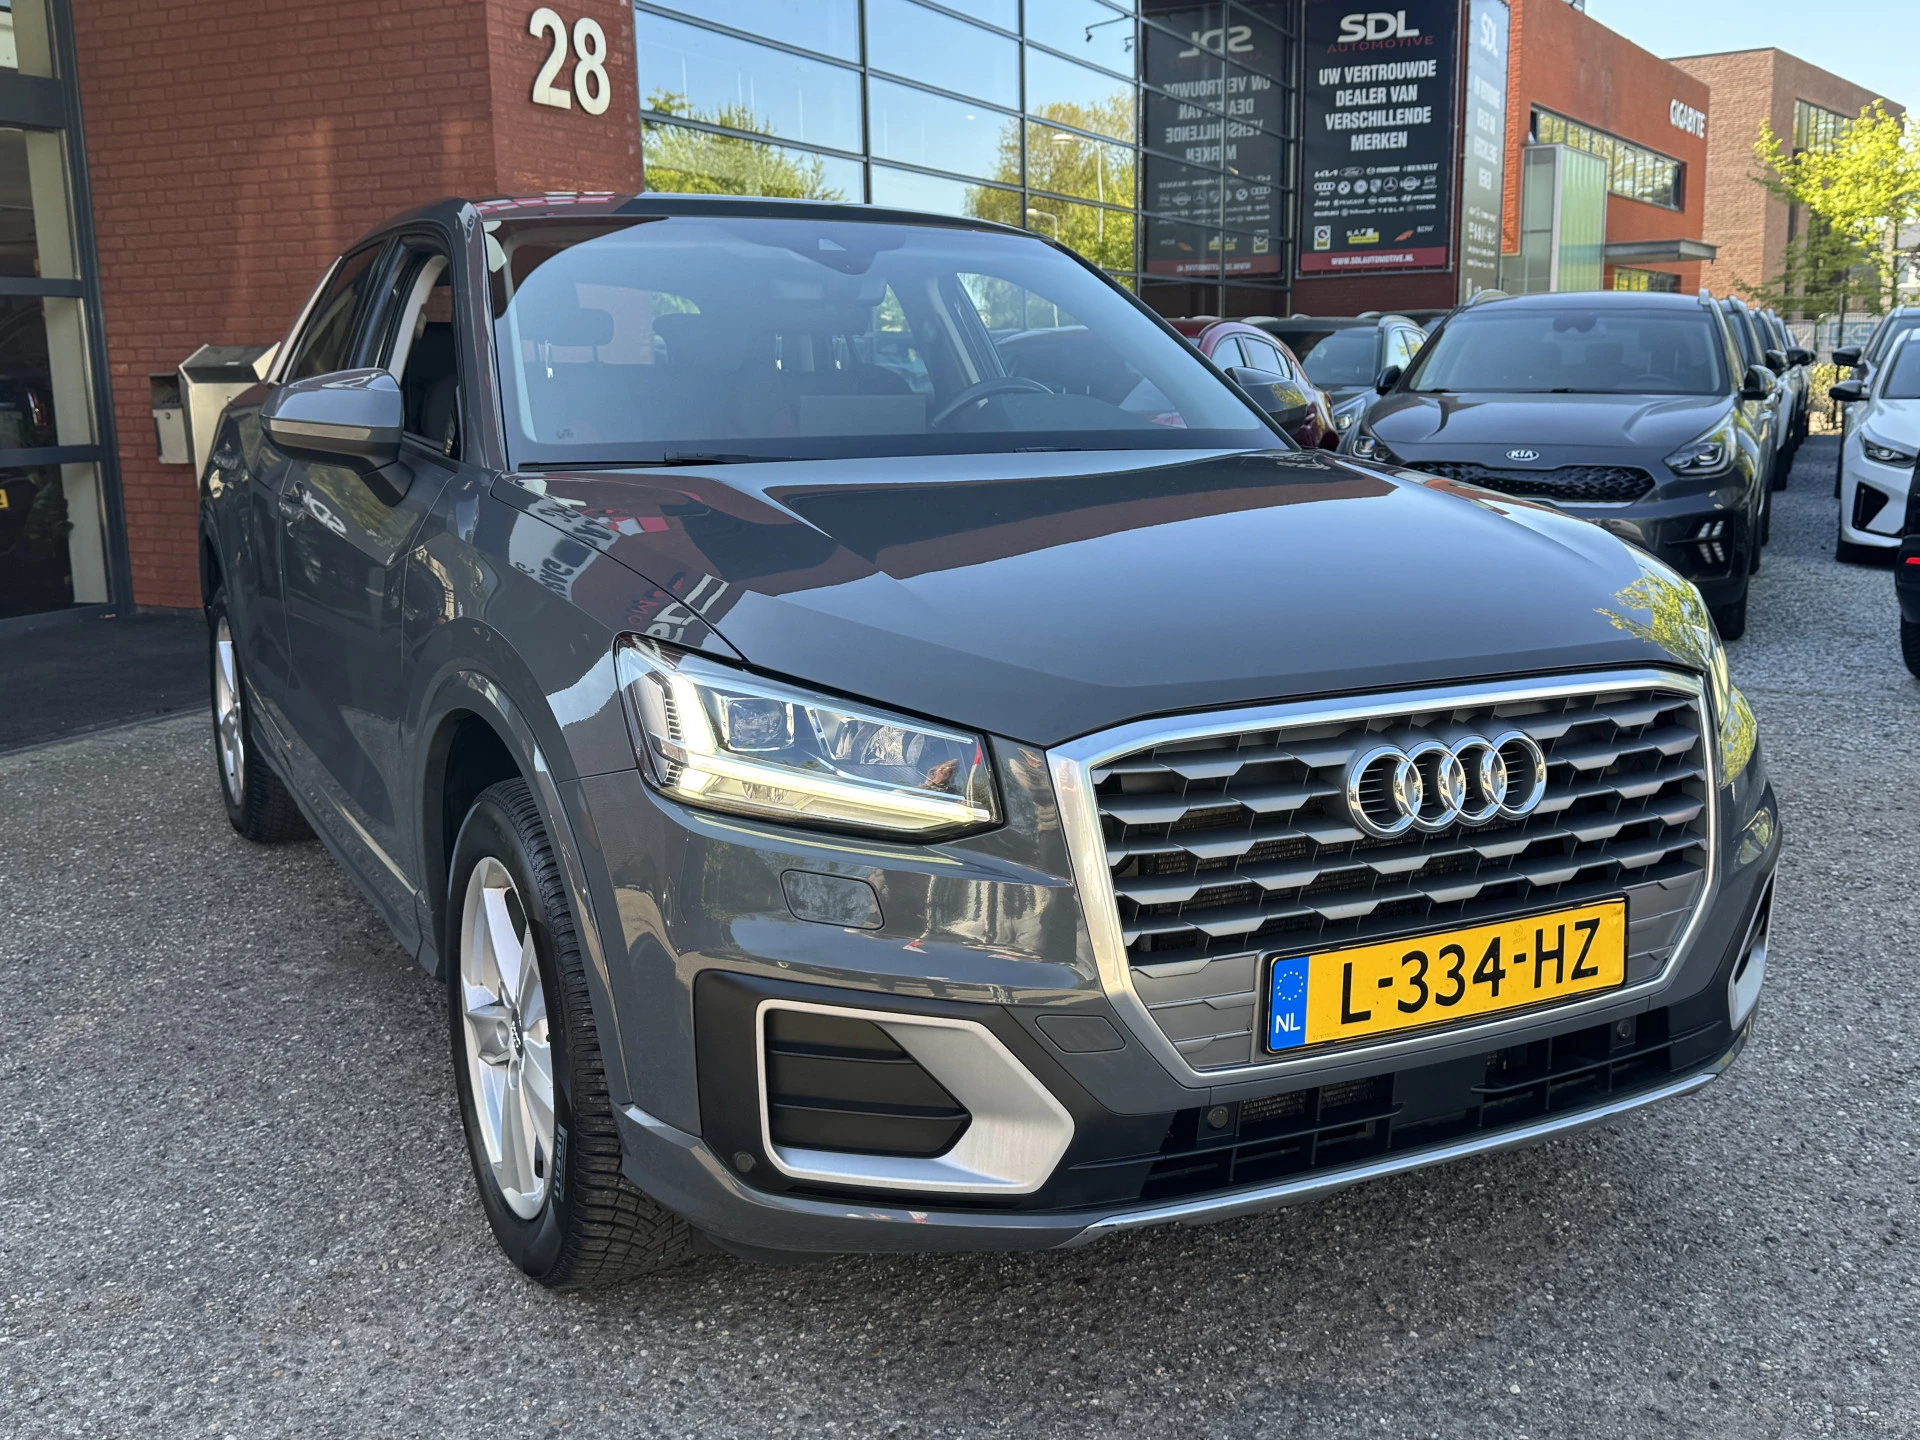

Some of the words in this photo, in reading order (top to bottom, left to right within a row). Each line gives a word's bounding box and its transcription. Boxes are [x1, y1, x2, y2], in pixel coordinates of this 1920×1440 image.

[1337, 10, 1420, 43] SDL
[1327, 35, 1434, 54] AUTOMOTIVE
[530, 8, 611, 115] 28
[1318, 68, 1341, 86] UW
[1344, 59, 1437, 83] VERTROUWDE
[1335, 87, 1386, 107] DEALER
[1390, 84, 1418, 103] VAN
[1325, 106, 1432, 130] VERSCHILLENDE
[1670, 98, 1705, 139] GIGABYTE
[1350, 131, 1408, 151] MERKEN
[1510, 450, 1534, 458] KIA
[1340, 917, 1601, 1025] L-334-HZ
[1275, 1012, 1301, 1034] NL
